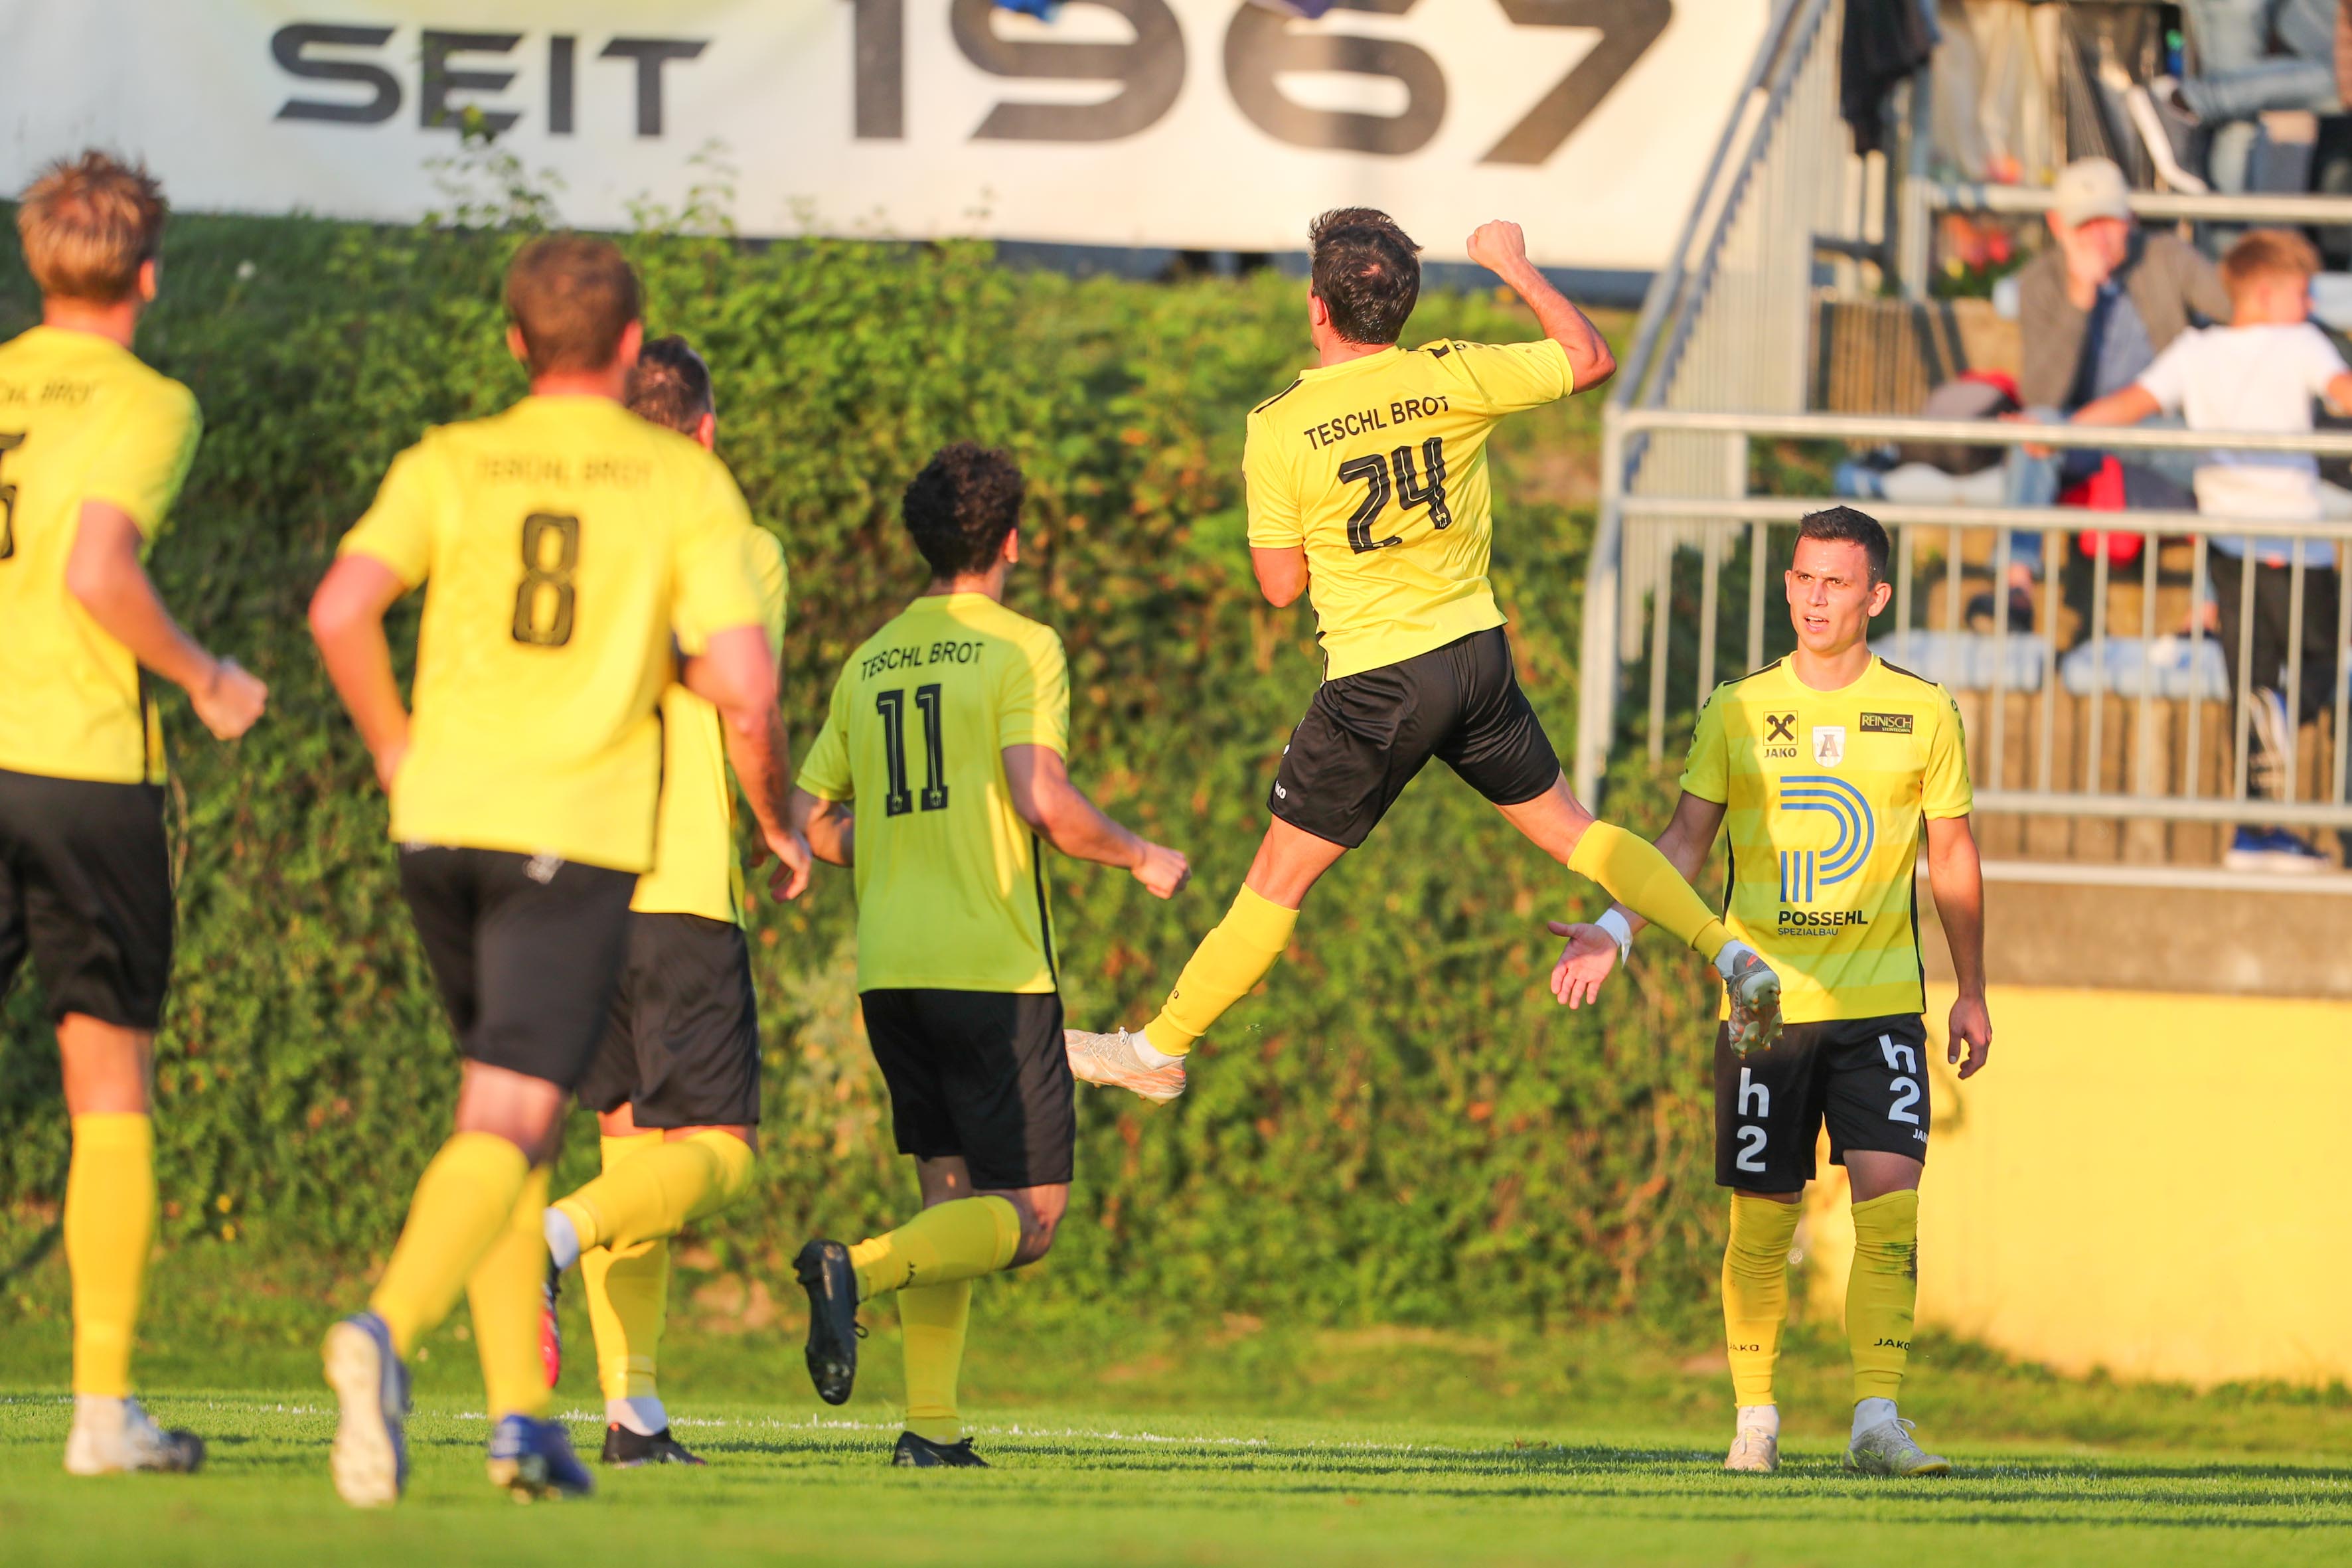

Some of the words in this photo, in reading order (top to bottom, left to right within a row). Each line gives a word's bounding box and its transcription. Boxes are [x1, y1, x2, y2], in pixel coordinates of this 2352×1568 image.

[270, 23, 711, 138] SEIT
[854, 0, 1673, 164] 1967
[1303, 408, 1387, 450] TESCHL
[1390, 396, 1449, 425] BROT
[1338, 436, 1452, 555] 24
[512, 512, 580, 647] 8
[860, 646, 923, 682] TESCHL
[929, 641, 984, 665] BROT
[1861, 715, 1912, 729] REINISCH
[876, 683, 949, 818] 11
[1764, 747, 1798, 759] JAKO
[1818, 734, 1840, 757] A
[1778, 910, 1868, 927] POSSEHL
[1777, 927, 1839, 937] SPEZIALBAU
[1913, 1128, 1928, 1144] JAK
[1729, 1342, 1760, 1352] JAKO
[1873, 1338, 1911, 1351] JAKO
